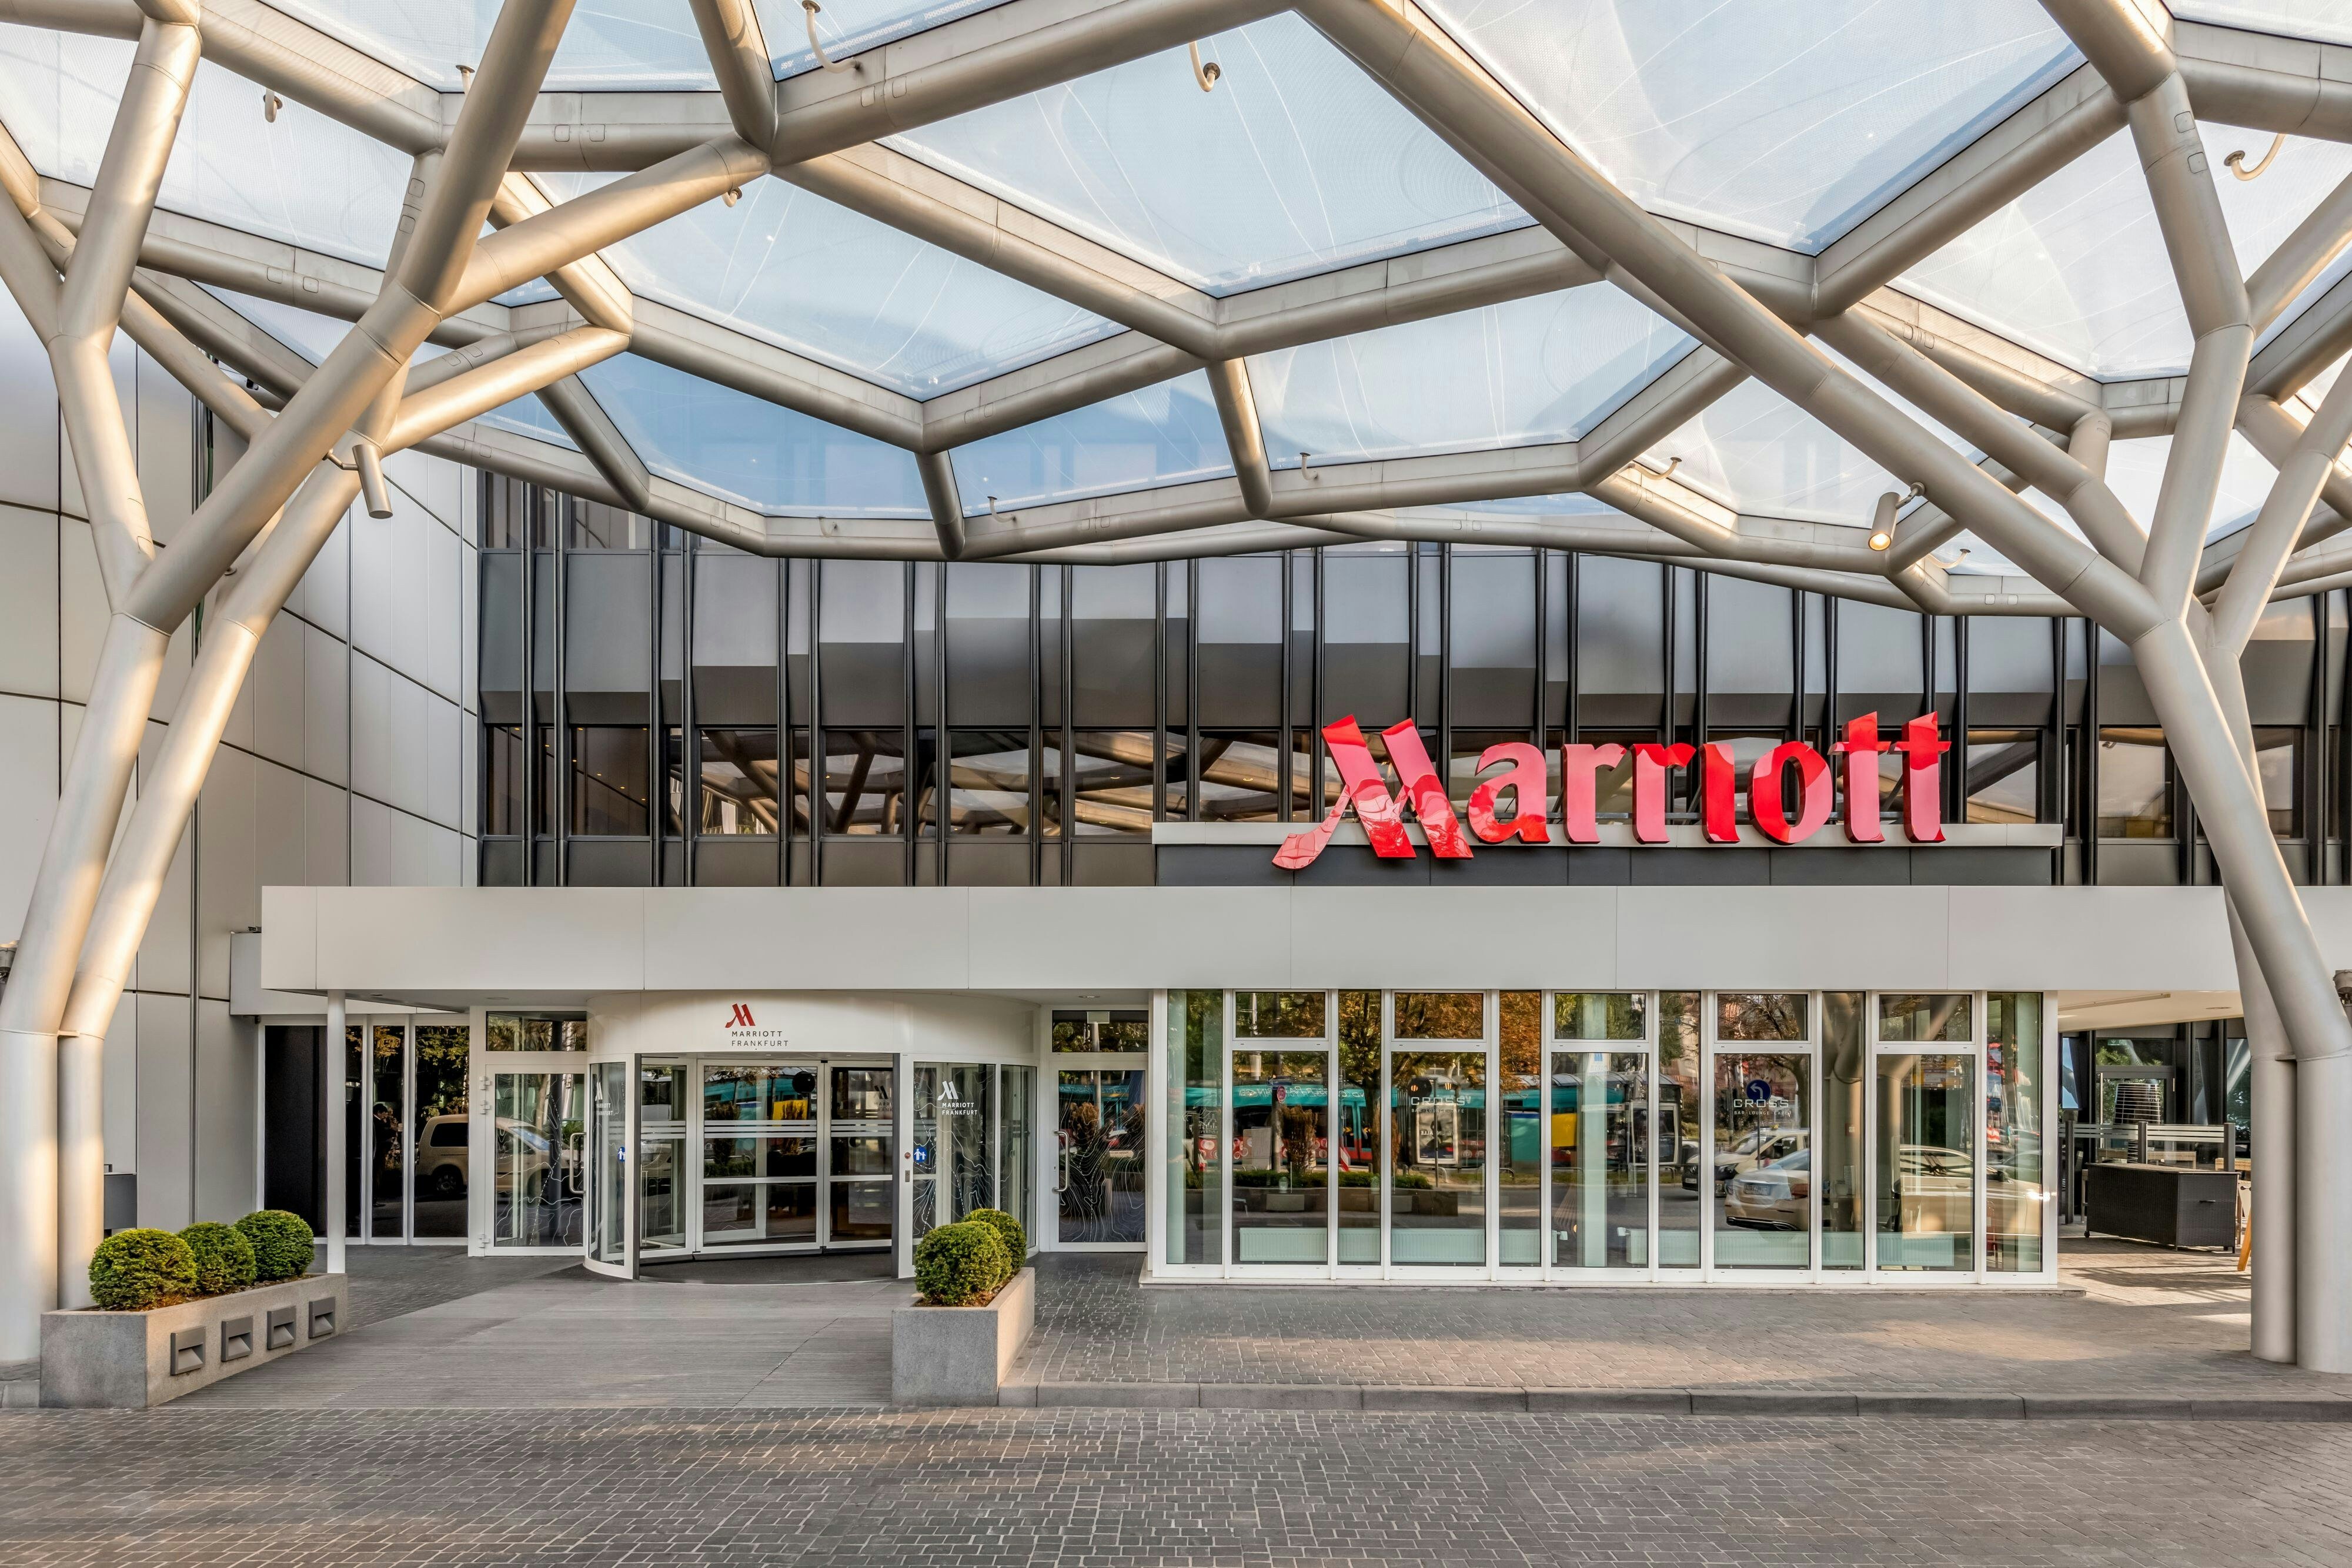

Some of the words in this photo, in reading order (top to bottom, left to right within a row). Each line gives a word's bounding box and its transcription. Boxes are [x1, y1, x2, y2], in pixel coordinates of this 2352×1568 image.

[1271, 710, 1952, 871] Marriott
[1411, 1097, 1465, 1105] CROSS
[1733, 1099, 1788, 1108] CROSS
